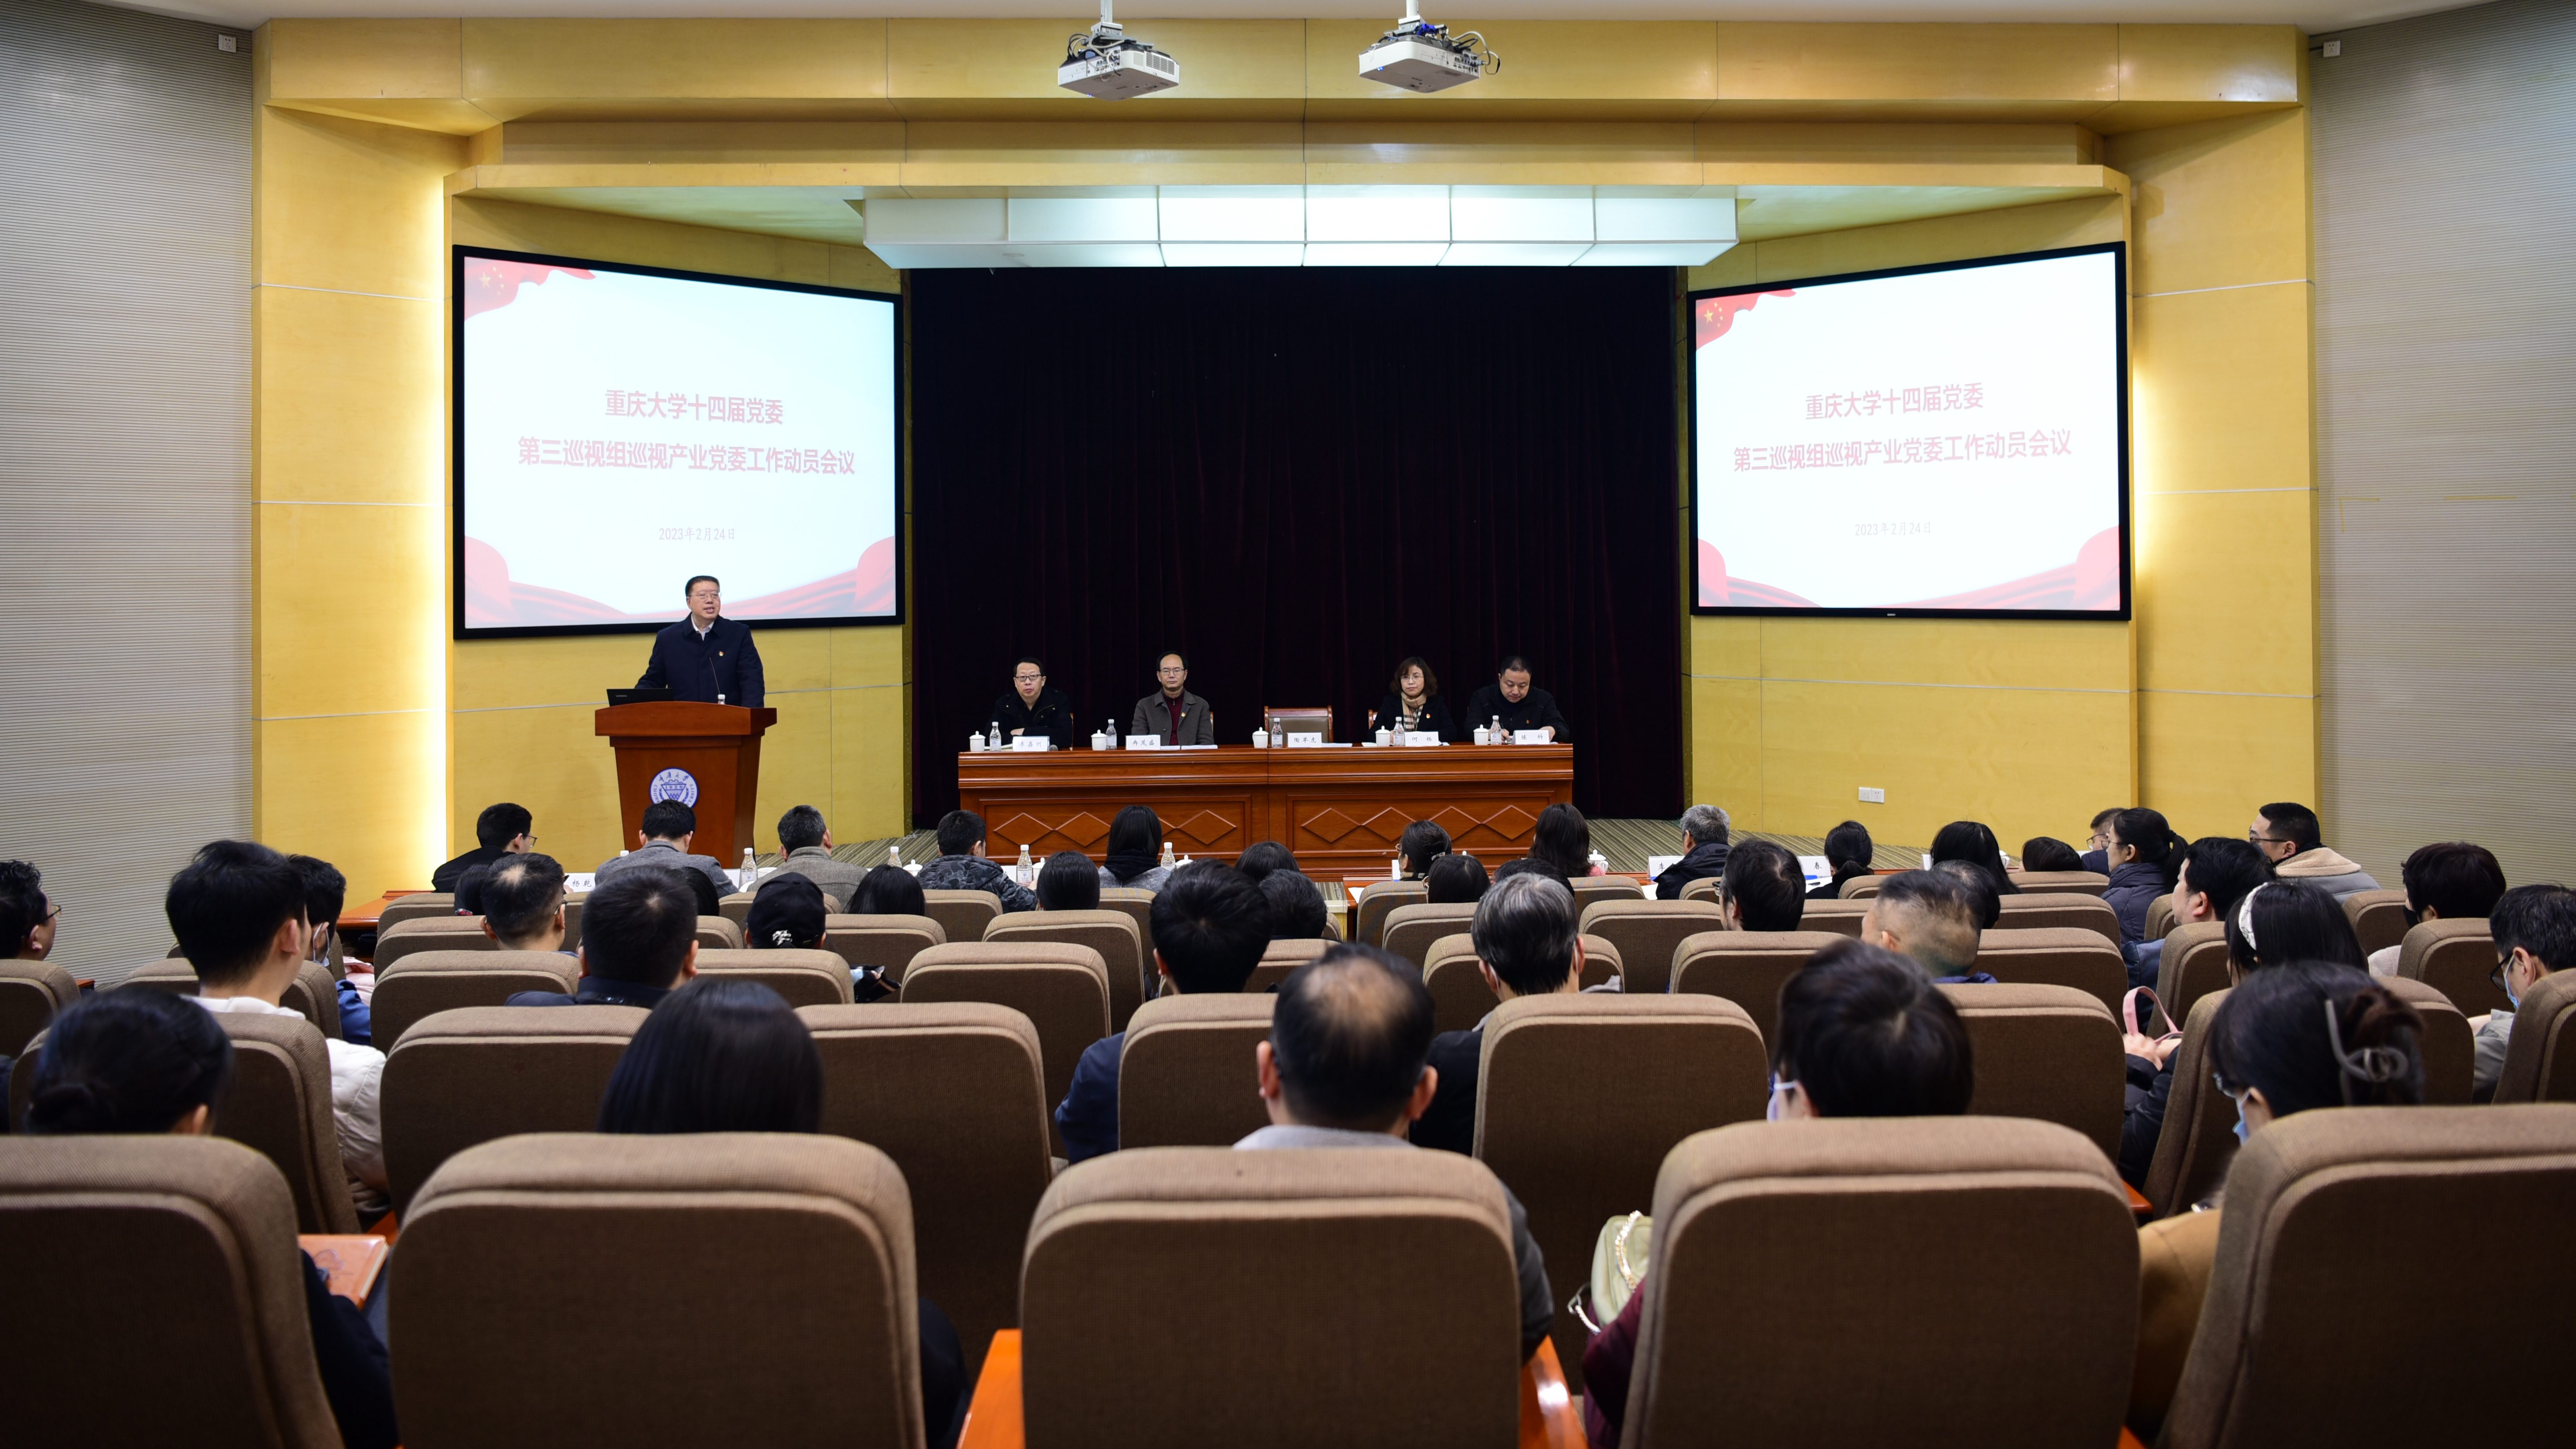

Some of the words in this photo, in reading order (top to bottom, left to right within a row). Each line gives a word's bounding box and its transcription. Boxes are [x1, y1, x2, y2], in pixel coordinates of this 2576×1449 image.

[604, 389, 784, 426] 重庆大学十四届党委
[1805, 382, 1984, 421] 重庆大学十四届党委
[518, 436, 856, 476] 第三巡视组巡视产业党委工作动员会议
[1733, 428, 2073, 473] 第三巡视组巡视产业党委工作动员会议
[658, 527, 735, 542] 2023年2月24日
[1855, 522, 1931, 537] 2023年2月24日
